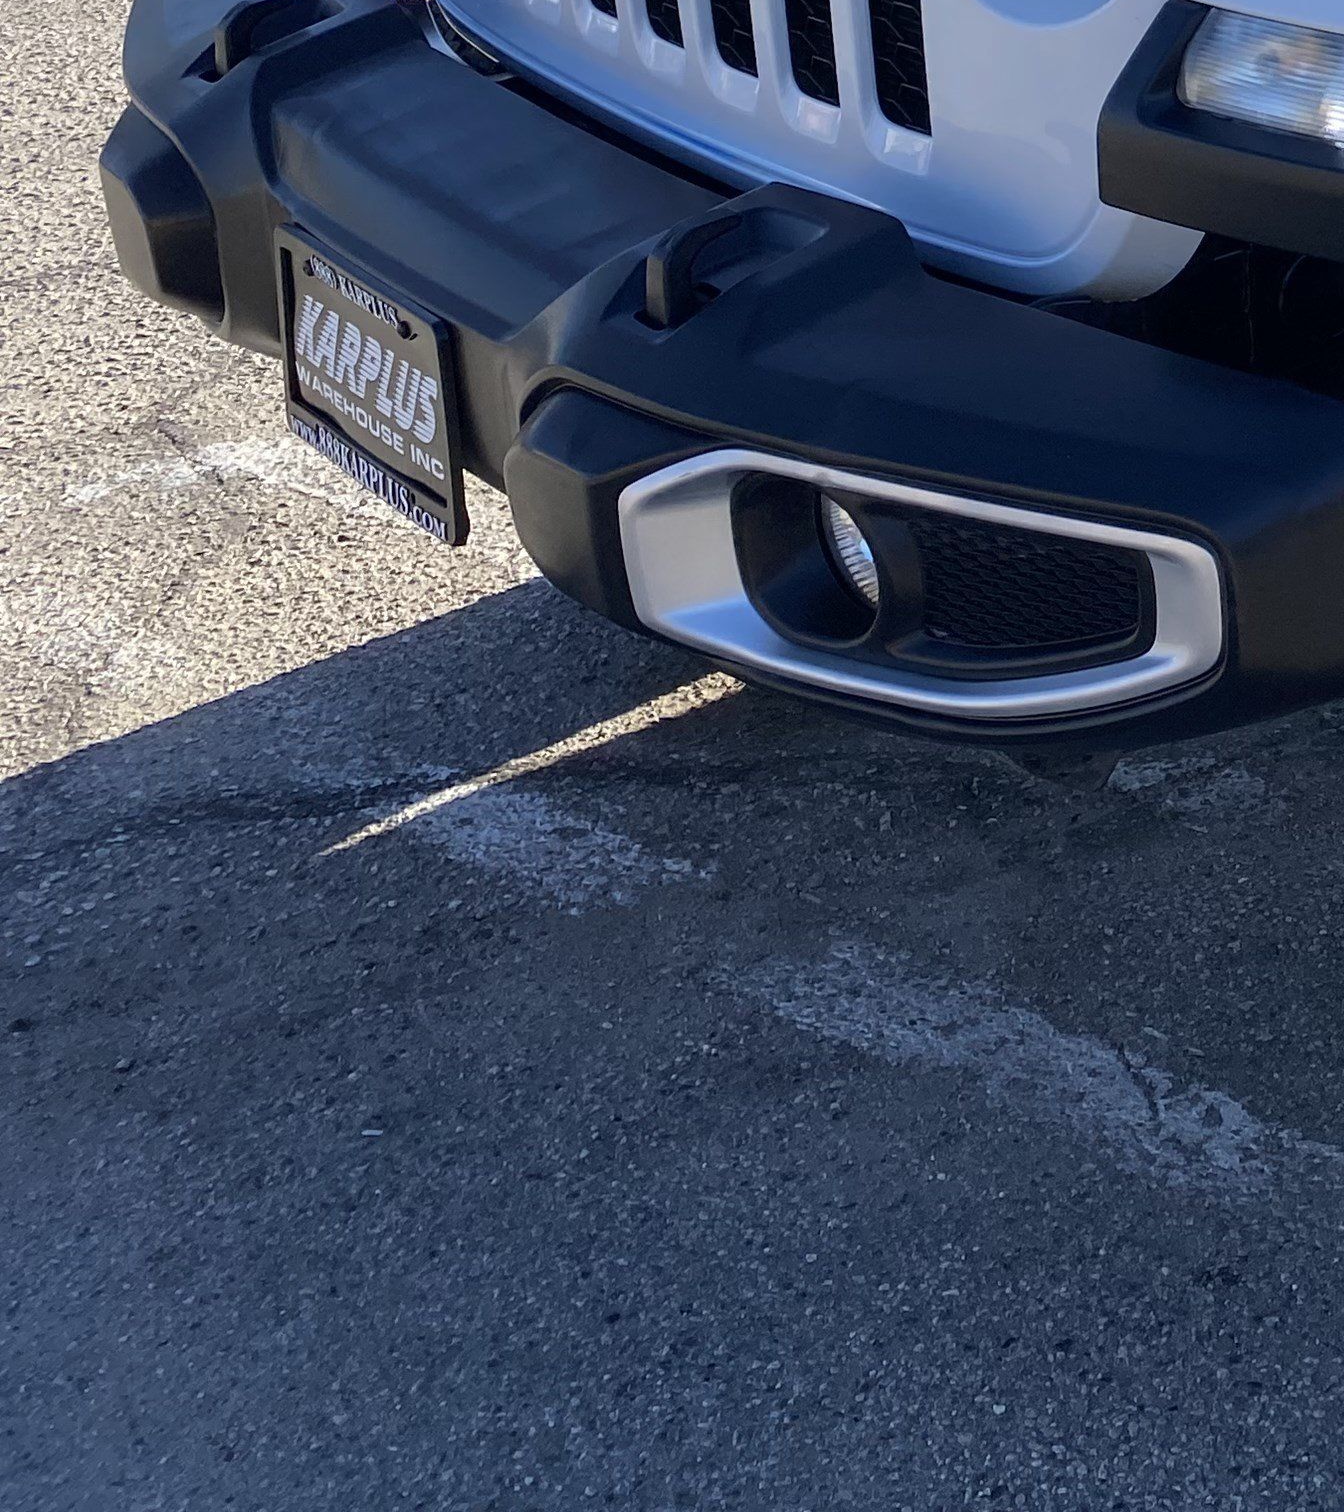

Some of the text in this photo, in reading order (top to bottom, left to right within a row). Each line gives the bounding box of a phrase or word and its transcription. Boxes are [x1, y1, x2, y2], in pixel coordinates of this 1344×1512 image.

[310, 254, 399, 331] (888) KARPLUS
[295, 361, 446, 481] WAREHOUSE INC
[296, 294, 438, 445] KARPLUS
